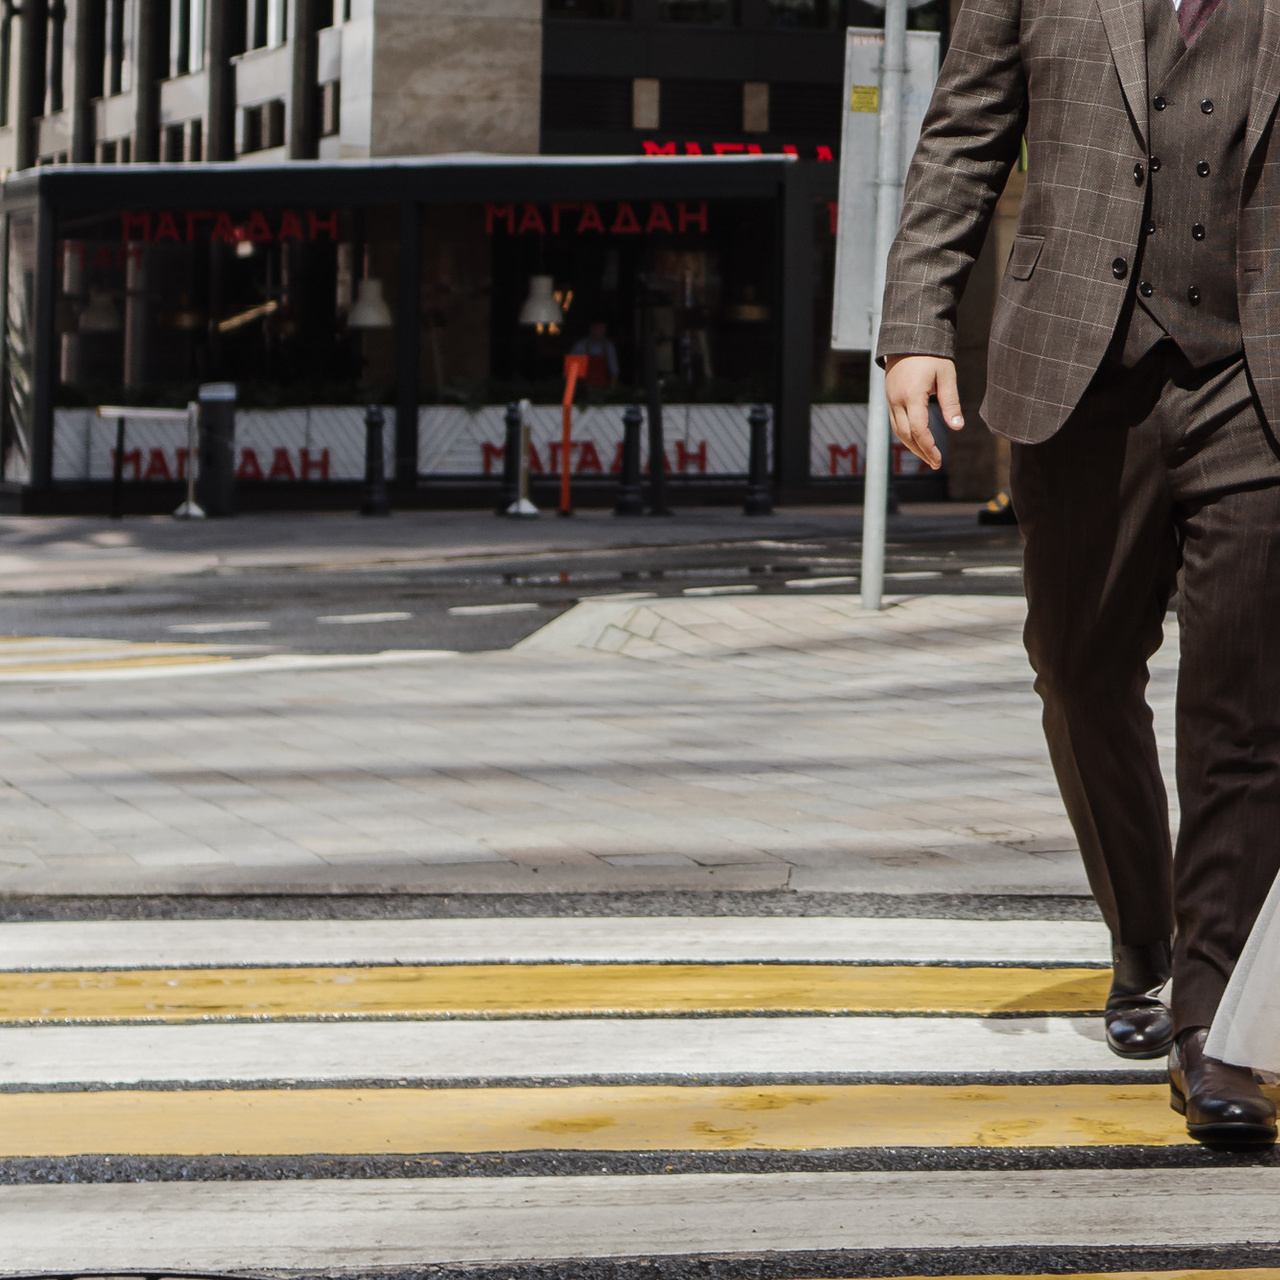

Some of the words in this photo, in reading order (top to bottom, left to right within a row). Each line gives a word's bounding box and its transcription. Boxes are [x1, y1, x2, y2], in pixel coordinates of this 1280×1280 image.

[121, 210, 338, 243] МАГАДАН
[485, 201, 708, 234] МАГАДАН
[111, 446, 330, 480] МАГДАН
